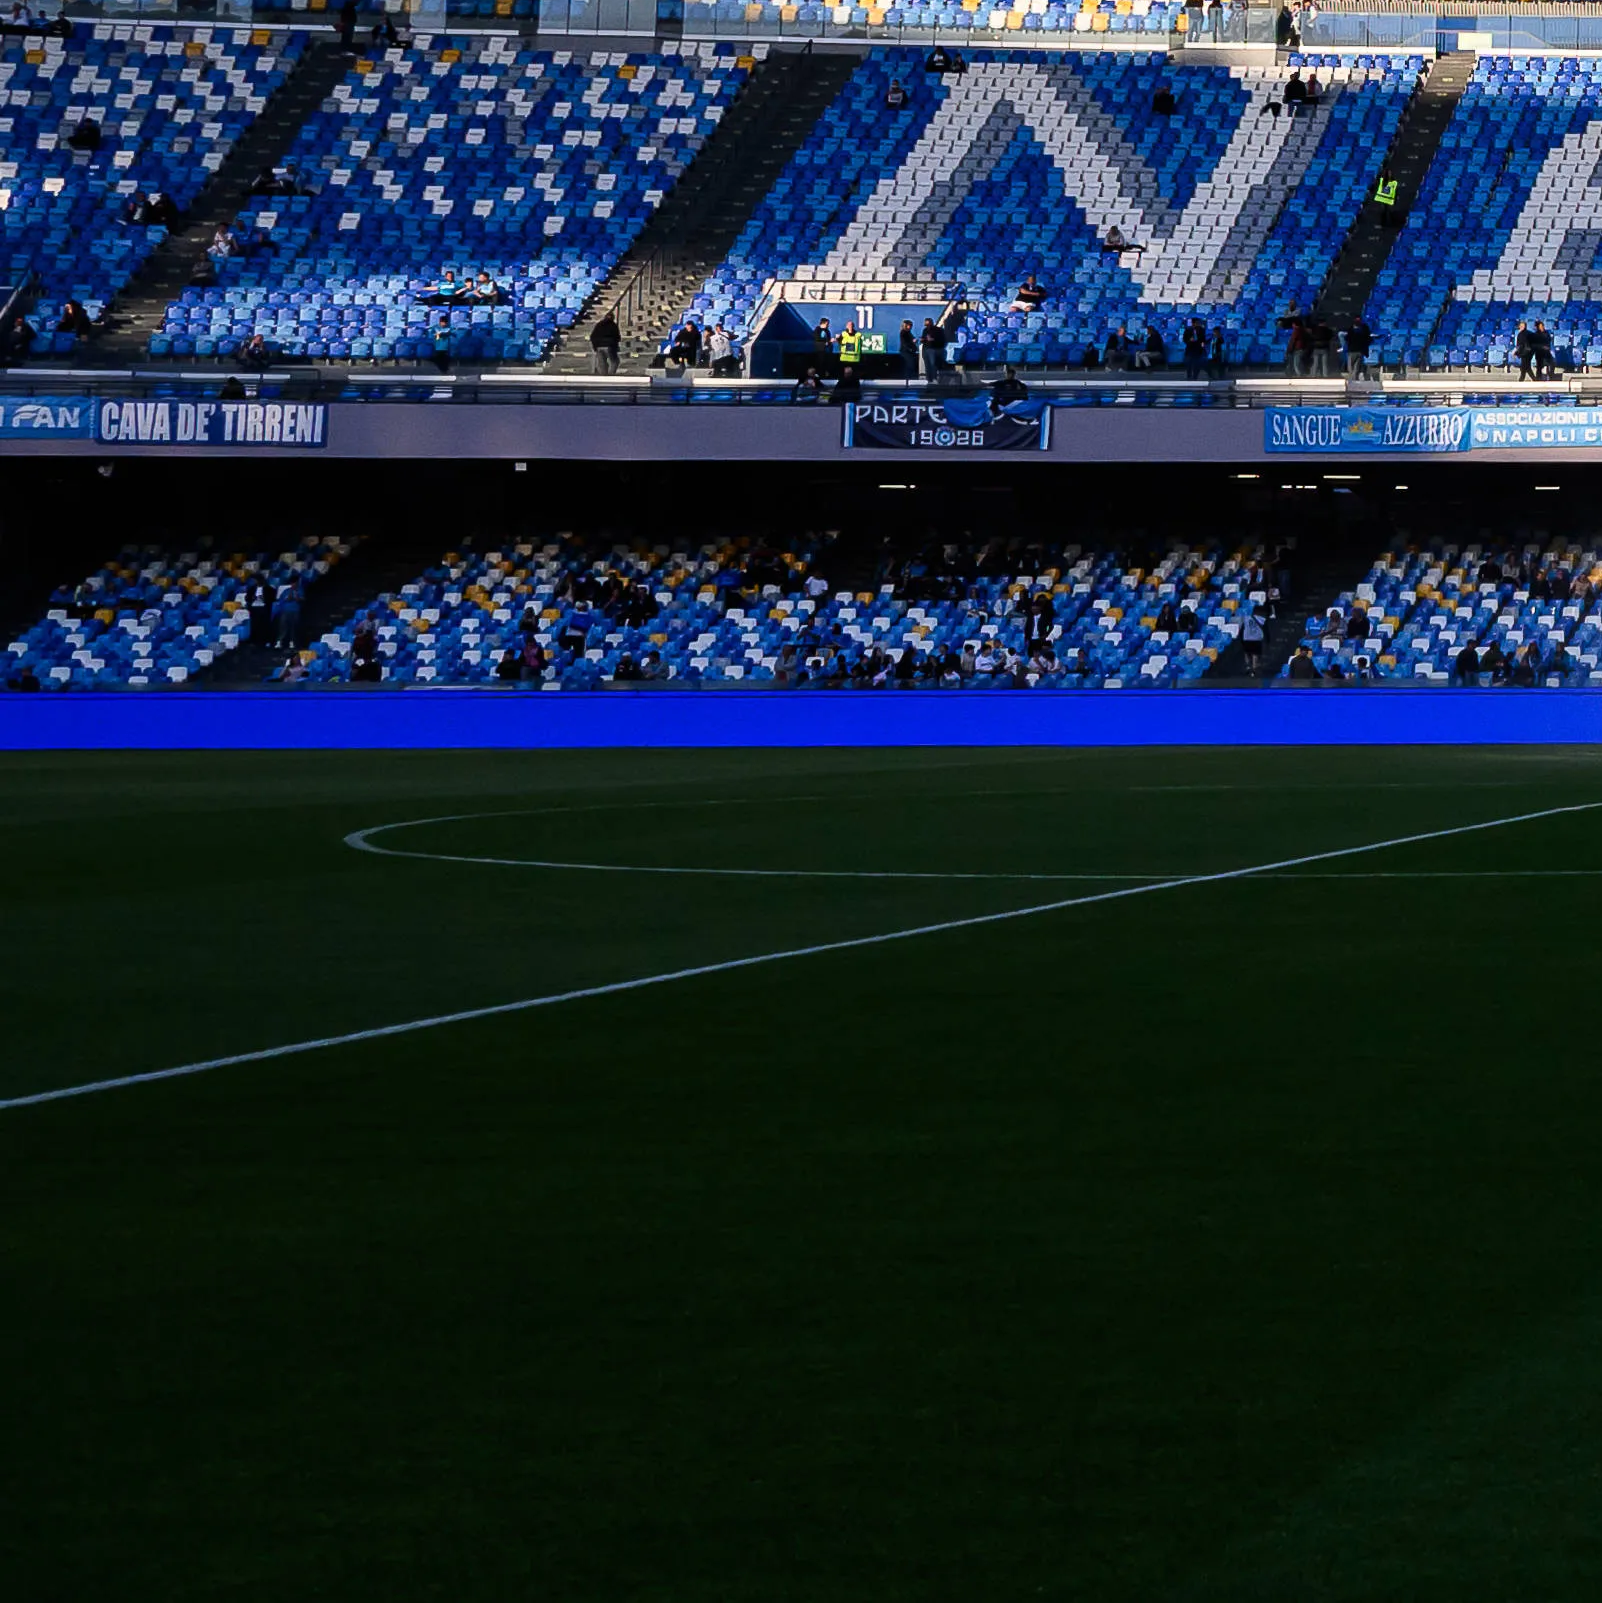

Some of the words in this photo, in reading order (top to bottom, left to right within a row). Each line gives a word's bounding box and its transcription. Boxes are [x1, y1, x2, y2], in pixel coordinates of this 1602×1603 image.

[855, 305, 874, 330] 11
[11, 404, 81, 428] FAN
[101, 402, 172, 441] CAVA
[176, 403, 216, 442] DE'
[221, 403, 325, 443] TIRRENI
[1474, 411, 1588, 426] ASSOCIAZIONE
[1272, 413, 1342, 446] SANGUE
[1382, 413, 1464, 447] AZZURRO
[1492, 428, 1576, 444] NAPOLI
